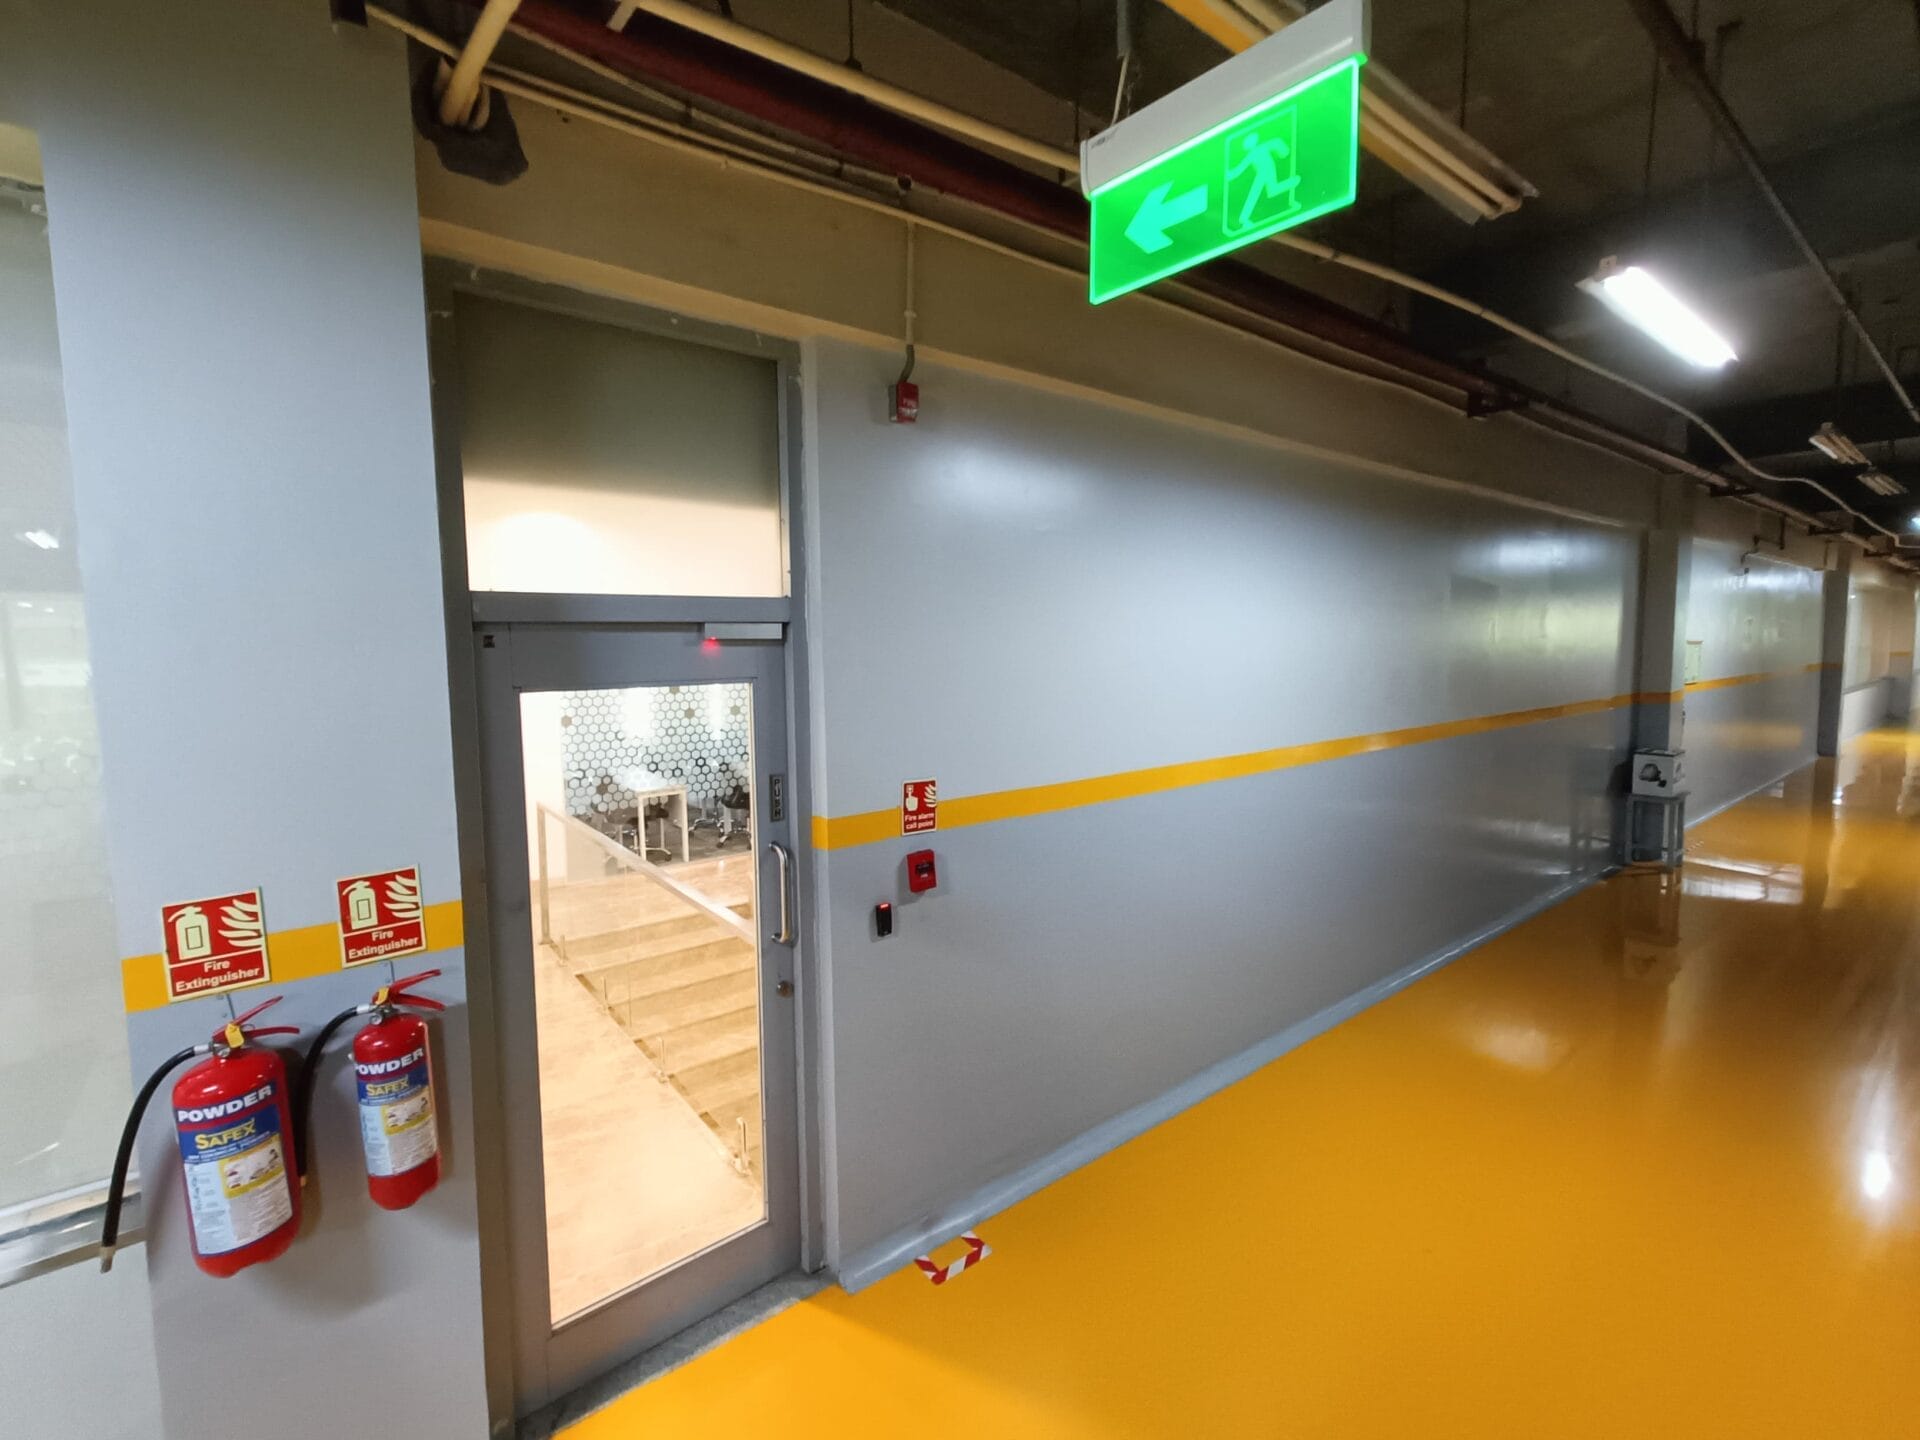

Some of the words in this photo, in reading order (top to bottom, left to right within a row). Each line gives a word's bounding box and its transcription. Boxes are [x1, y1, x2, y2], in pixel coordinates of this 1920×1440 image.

[905, 814, 917, 822] Fire
[918, 812, 934, 820] alarm
[906, 822, 917, 830] call
[918, 820, 933, 829] point
[372, 928, 394, 942] Fire
[348, 936, 419, 960] Extinguisher
[203, 959, 231, 973] Fire
[176, 966, 260, 992] Extinguisher
[178, 1085, 272, 1122] POWDER
